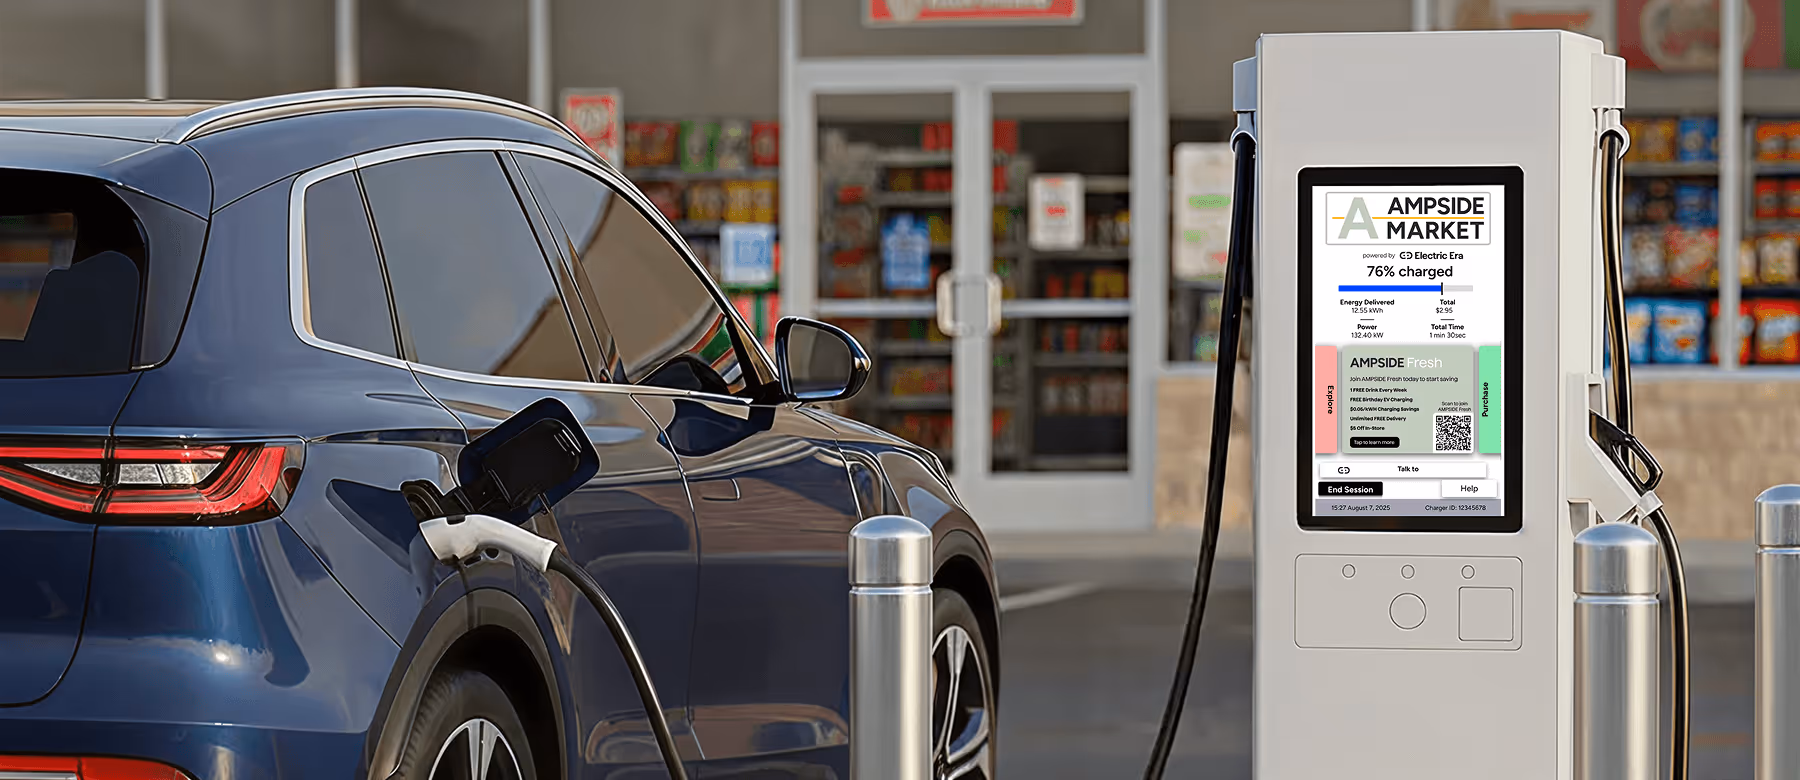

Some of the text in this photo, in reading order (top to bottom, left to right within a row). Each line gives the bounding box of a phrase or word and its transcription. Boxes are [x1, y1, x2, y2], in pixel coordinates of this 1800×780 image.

[1388, 197, 1484, 214] AMPSIDE
[1387, 222, 1484, 239] MARKET
[1414, 252, 1448, 260] Electric
[1449, 252, 1463, 260] Era
[1367, 266, 1453, 280] 76% charged
[1350, 357, 1442, 368] AMPSIDE Fresh
[1326, 385, 1335, 414] Explore
[1461, 485, 1478, 493] Help
